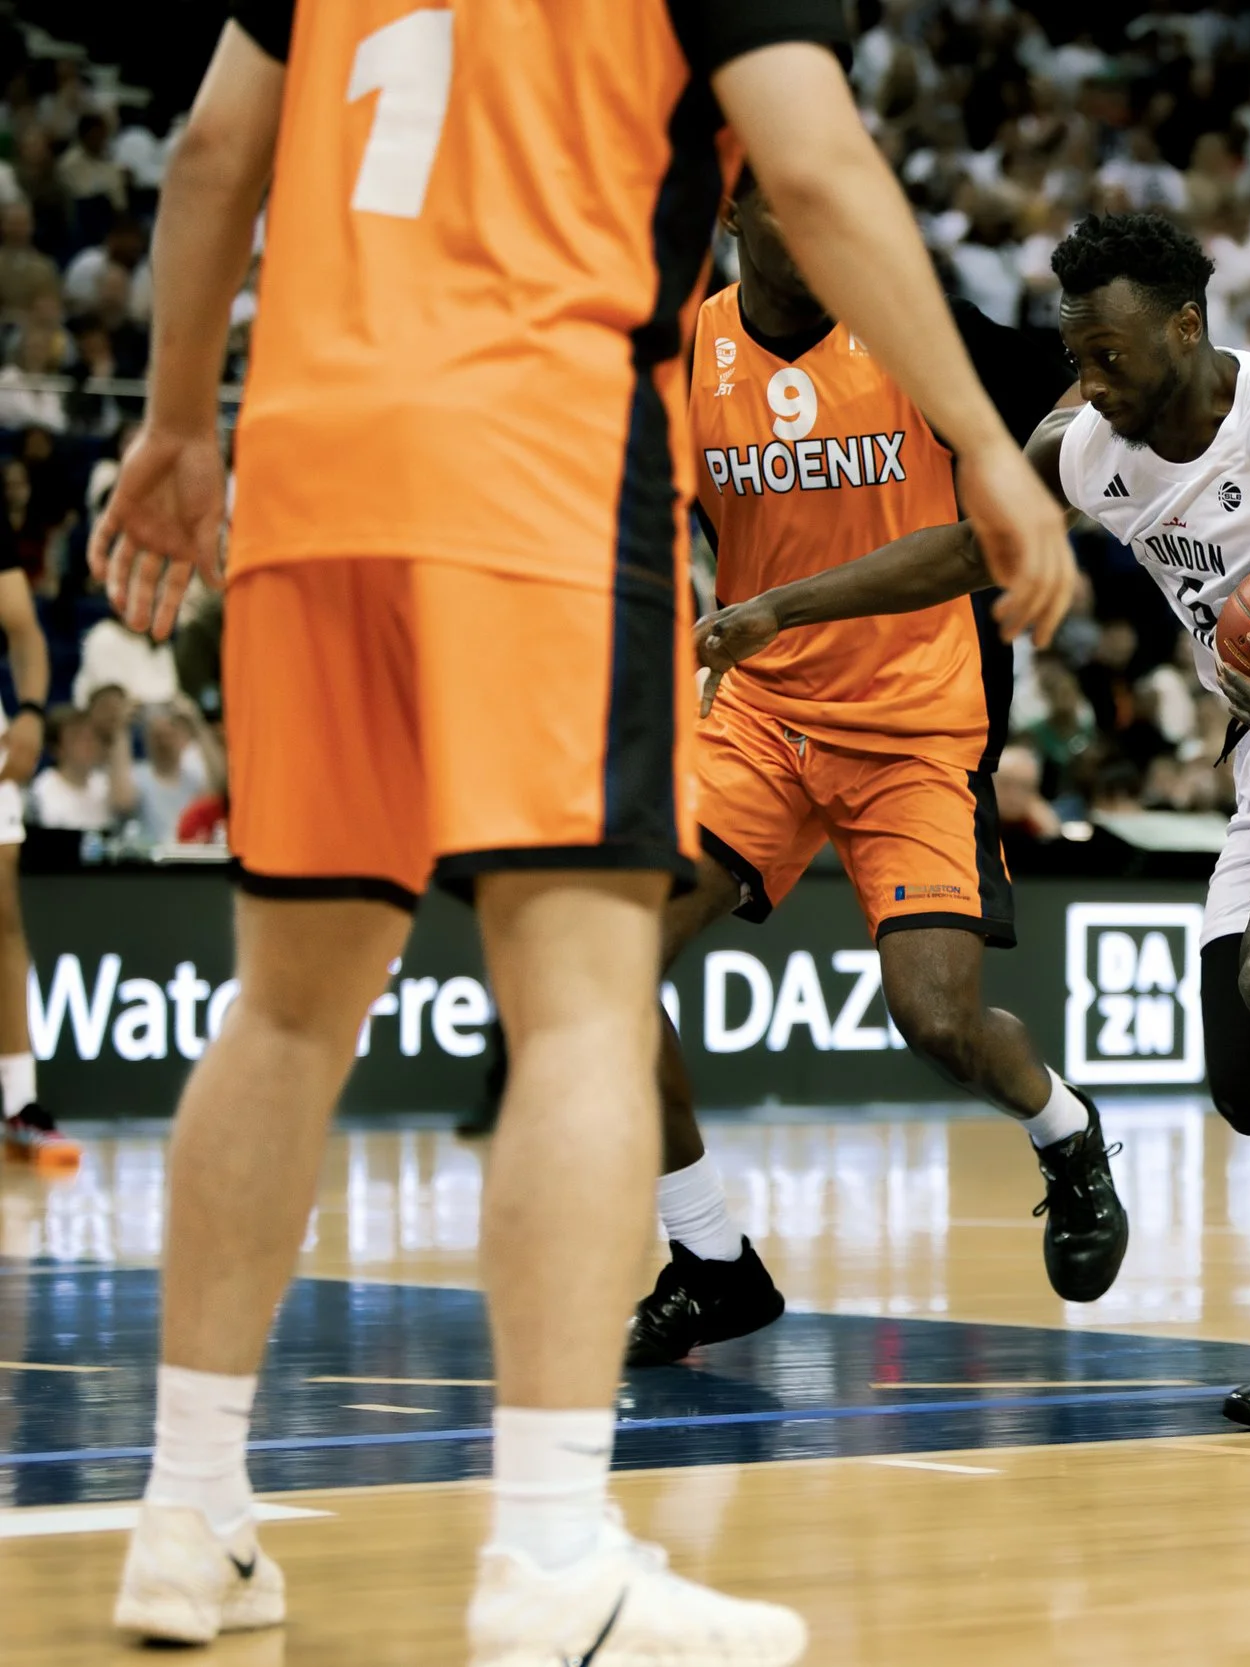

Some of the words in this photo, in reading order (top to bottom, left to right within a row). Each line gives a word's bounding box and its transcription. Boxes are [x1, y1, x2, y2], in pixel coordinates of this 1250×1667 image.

[347, 8, 454, 219] 1
[767, 367, 818, 440] 9
[704, 431, 907, 496] PHOENIX
[1138, 533, 1226, 577] ONDON
[1097, 931, 1178, 993] DA
[27, 953, 241, 1060] Watc
[355, 956, 498, 1058] re
[704, 949, 907, 1053] DAZ
